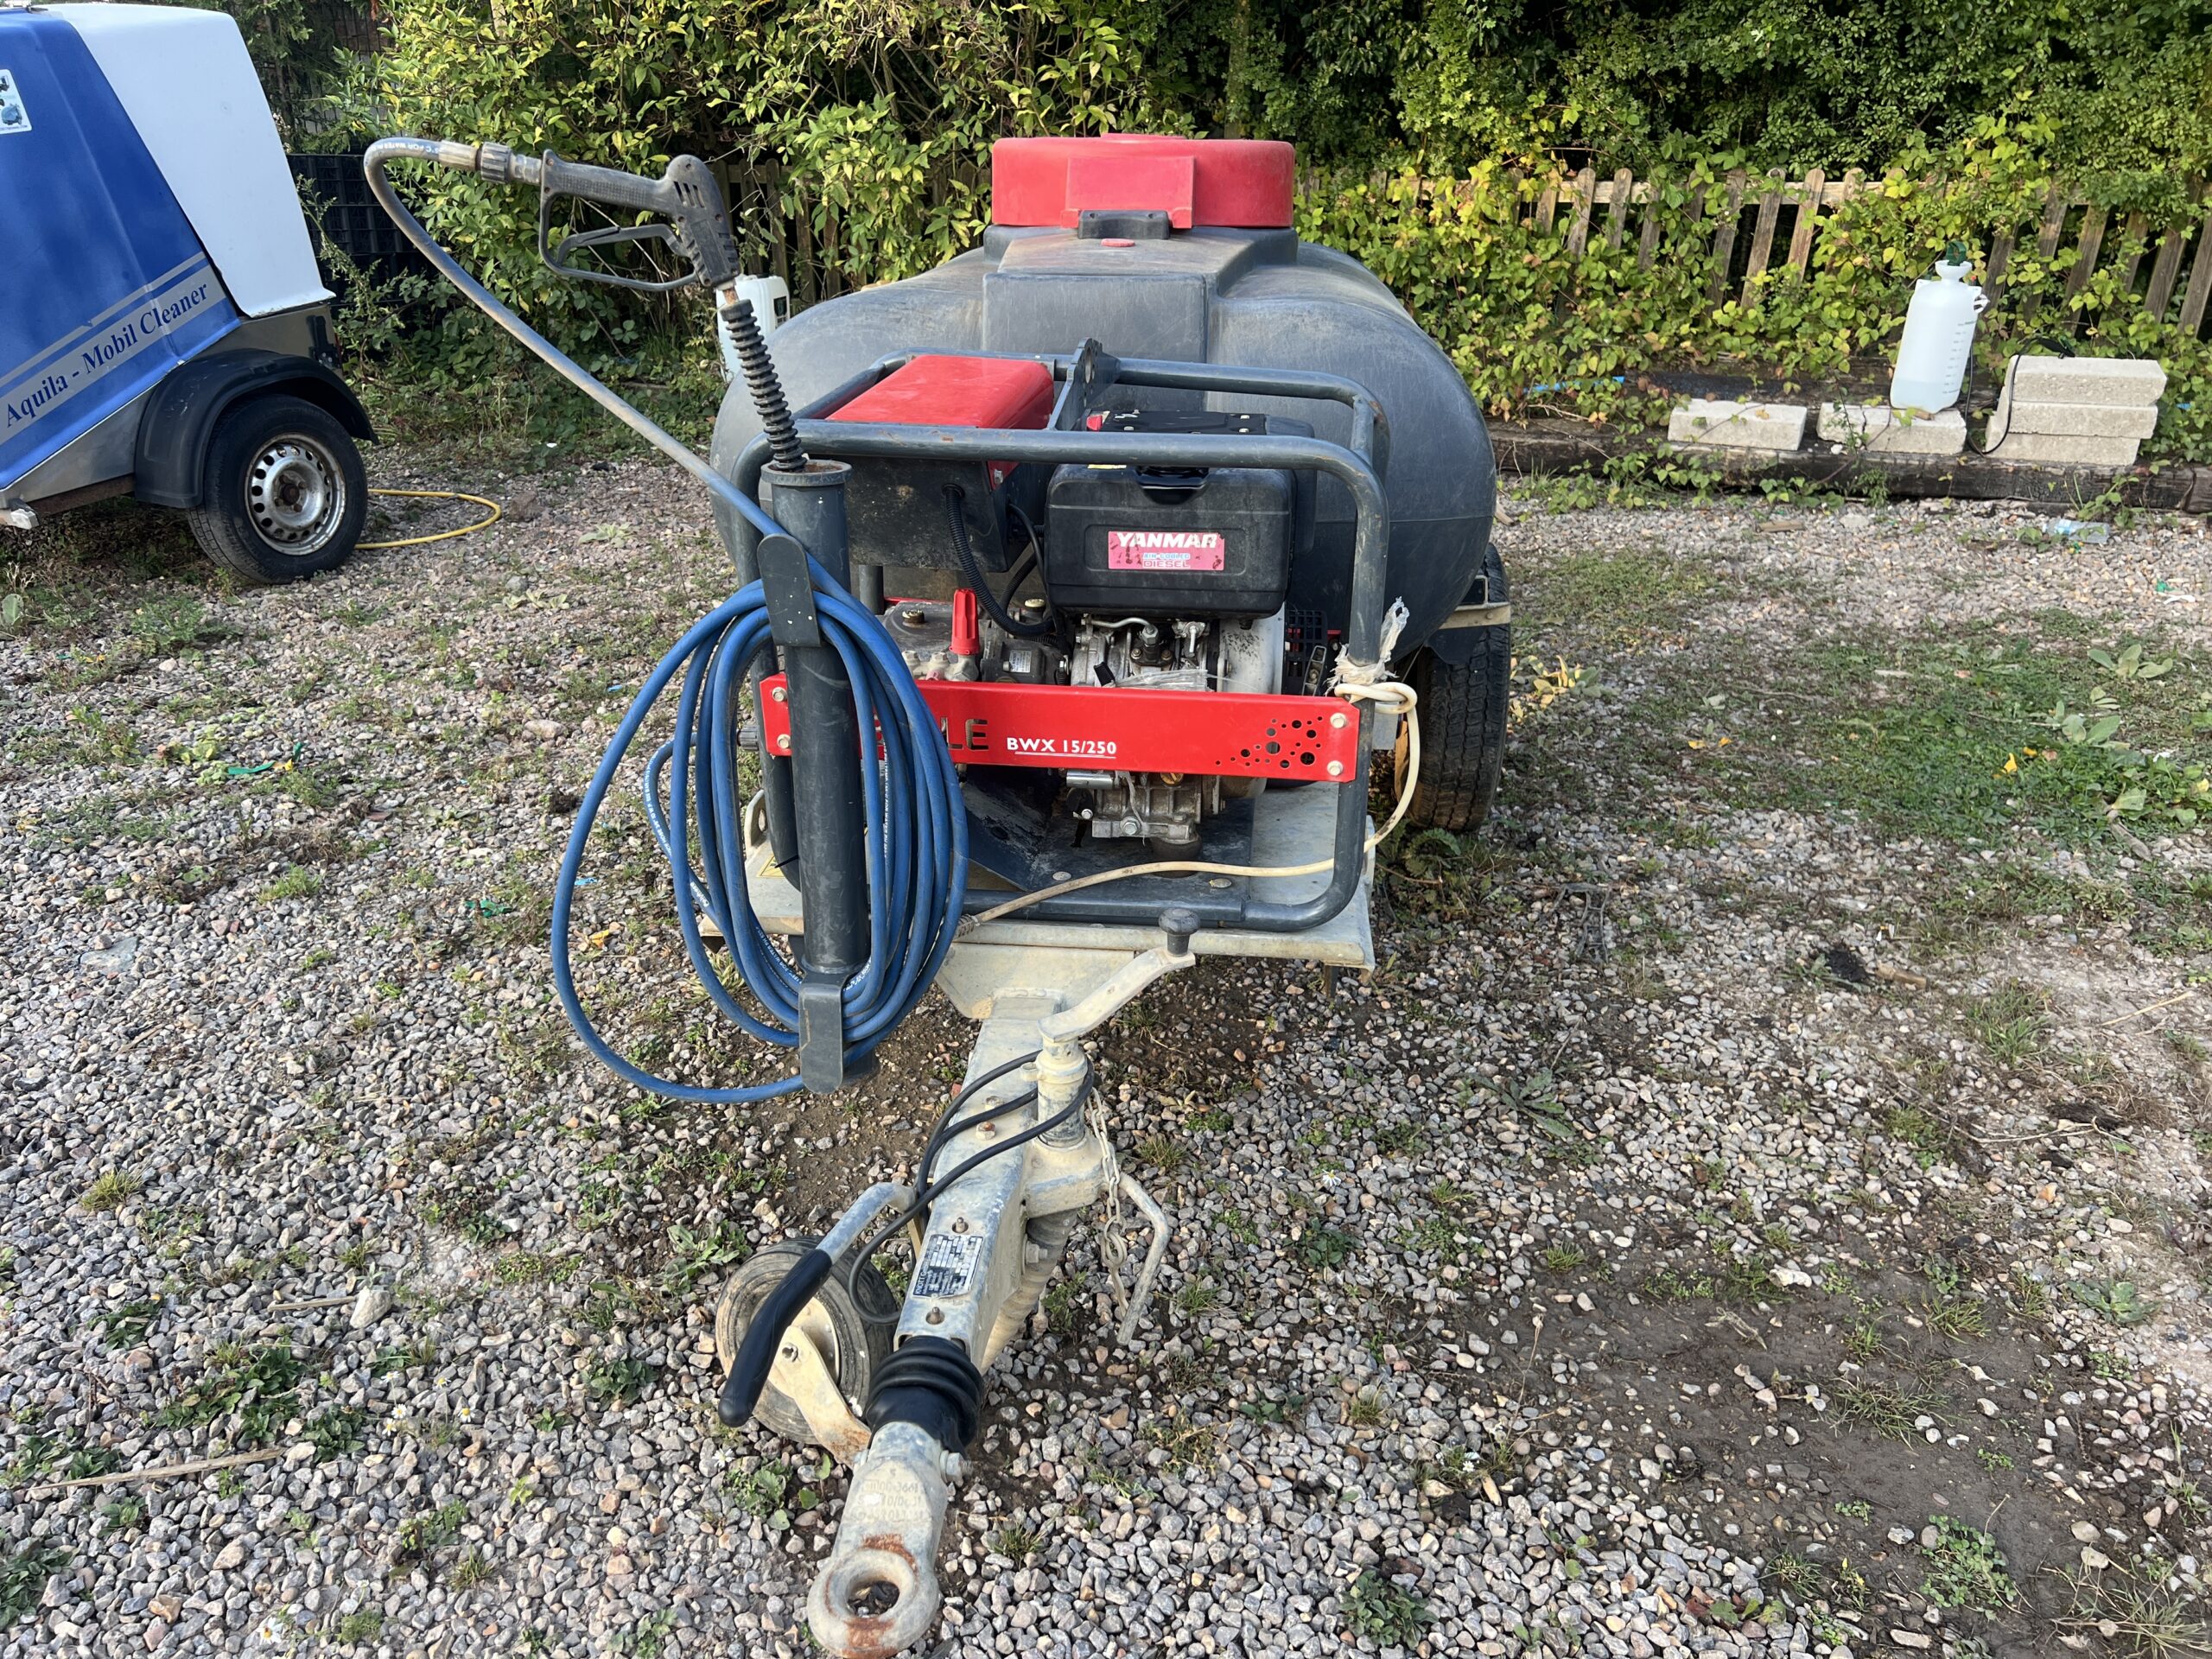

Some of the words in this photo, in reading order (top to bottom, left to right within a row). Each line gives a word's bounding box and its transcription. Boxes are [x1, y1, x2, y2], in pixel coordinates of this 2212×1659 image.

[7, 373, 69, 429] Aquila
[81, 324, 138, 375] Mobil
[140, 283, 207, 335] Cleaner
[1116, 531, 1217, 548] YANMAR
[1007, 737, 1056, 752] BWX
[1063, 740, 1116, 754] 15/250
